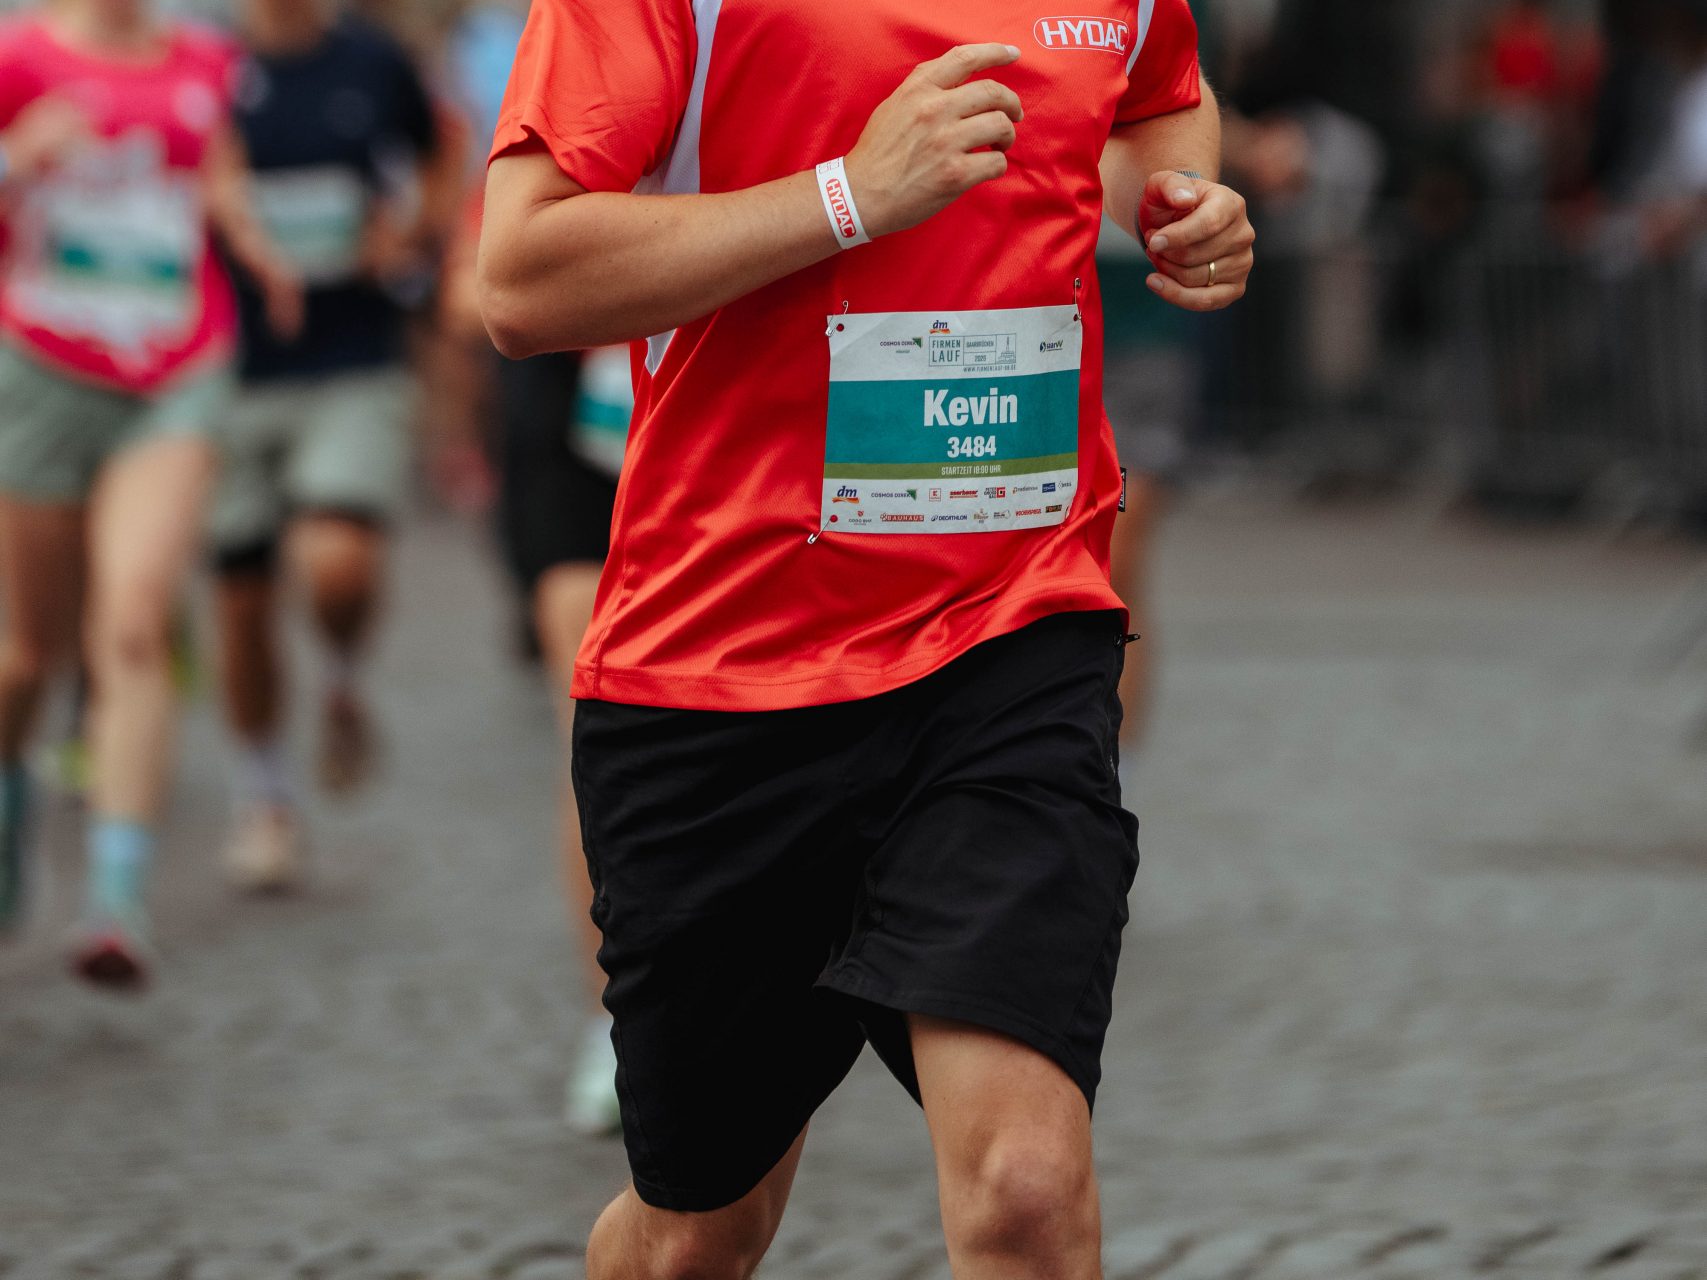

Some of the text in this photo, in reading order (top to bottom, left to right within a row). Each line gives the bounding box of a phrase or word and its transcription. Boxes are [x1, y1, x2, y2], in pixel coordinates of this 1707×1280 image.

[1041, 20, 1128, 51] HYDAC
[827, 180, 855, 236] HYDAC
[932, 320, 948, 329] dm
[932, 339, 961, 348] FIRMEN
[932, 350, 961, 362] LAUF
[923, 387, 1018, 427] Kevin
[947, 435, 996, 458] 3484
[941, 466, 972, 475] STARTZEIT
[989, 464, 1002, 473] UHR
[837, 486, 857, 497] dm
